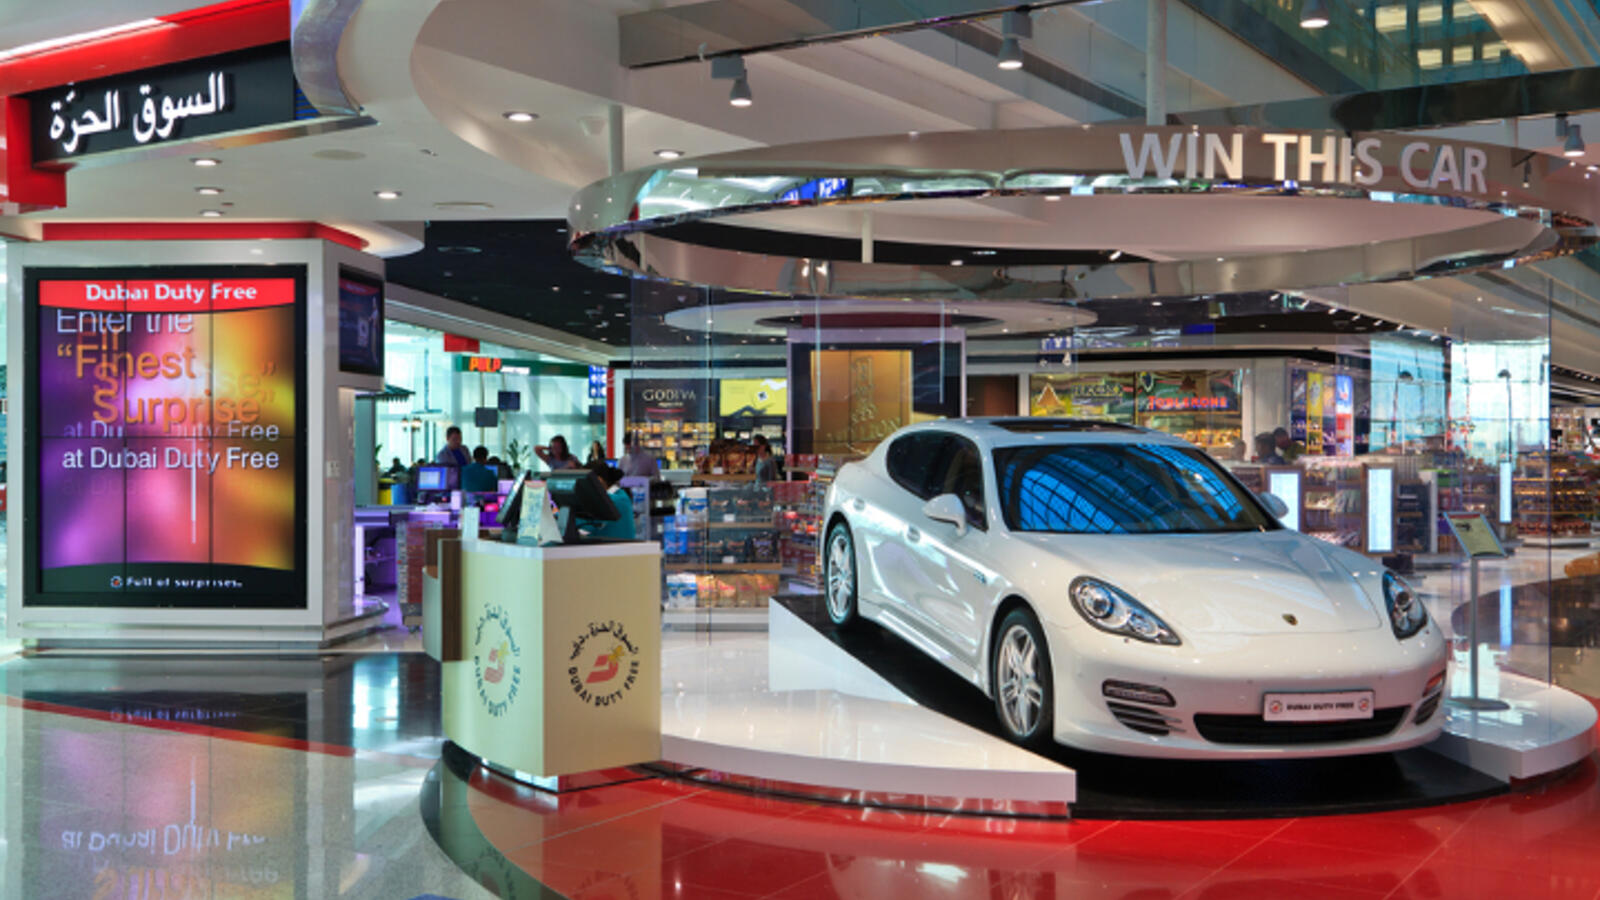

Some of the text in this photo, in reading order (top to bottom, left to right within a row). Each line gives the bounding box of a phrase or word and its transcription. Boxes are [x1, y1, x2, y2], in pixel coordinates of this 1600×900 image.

[132, 71, 225, 143] السوق
[1119, 133, 1487, 193] WIN THIS CAR
[85, 283, 257, 303] Dubai Duty Free
[642, 388, 697, 401] GODIVA
[62, 447, 279, 474] at Dubai Duty Free
[126, 577, 152, 586] Full
[157, 577, 170, 586] of
[568, 660, 639, 707] DUBAI DUTY FREE
[1286, 703, 1311, 711] DUBAI
[1313, 702, 1334, 710] DUTY
